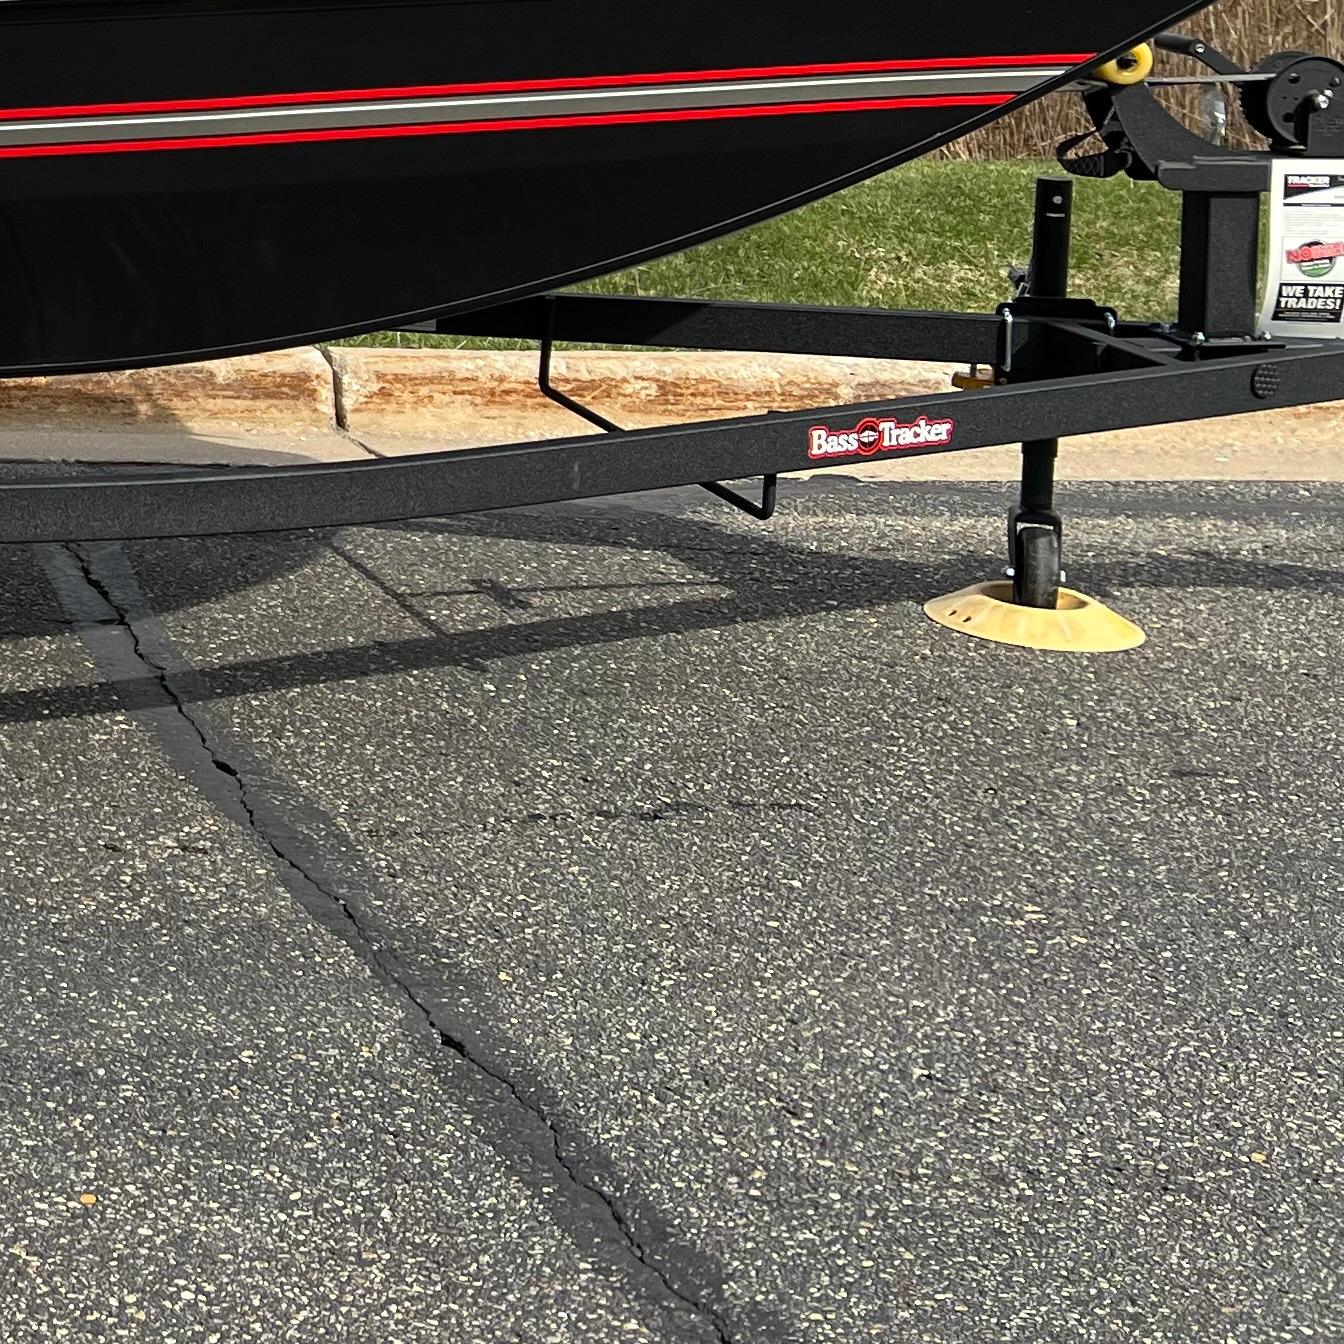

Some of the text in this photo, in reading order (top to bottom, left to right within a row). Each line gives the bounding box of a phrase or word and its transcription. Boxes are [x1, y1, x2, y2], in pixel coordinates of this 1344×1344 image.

[1282, 285, 1344, 298] WE TAKE
[1279, 297, 1342, 310] TRADES!
[810, 419, 952, 456] Bass Tracker
